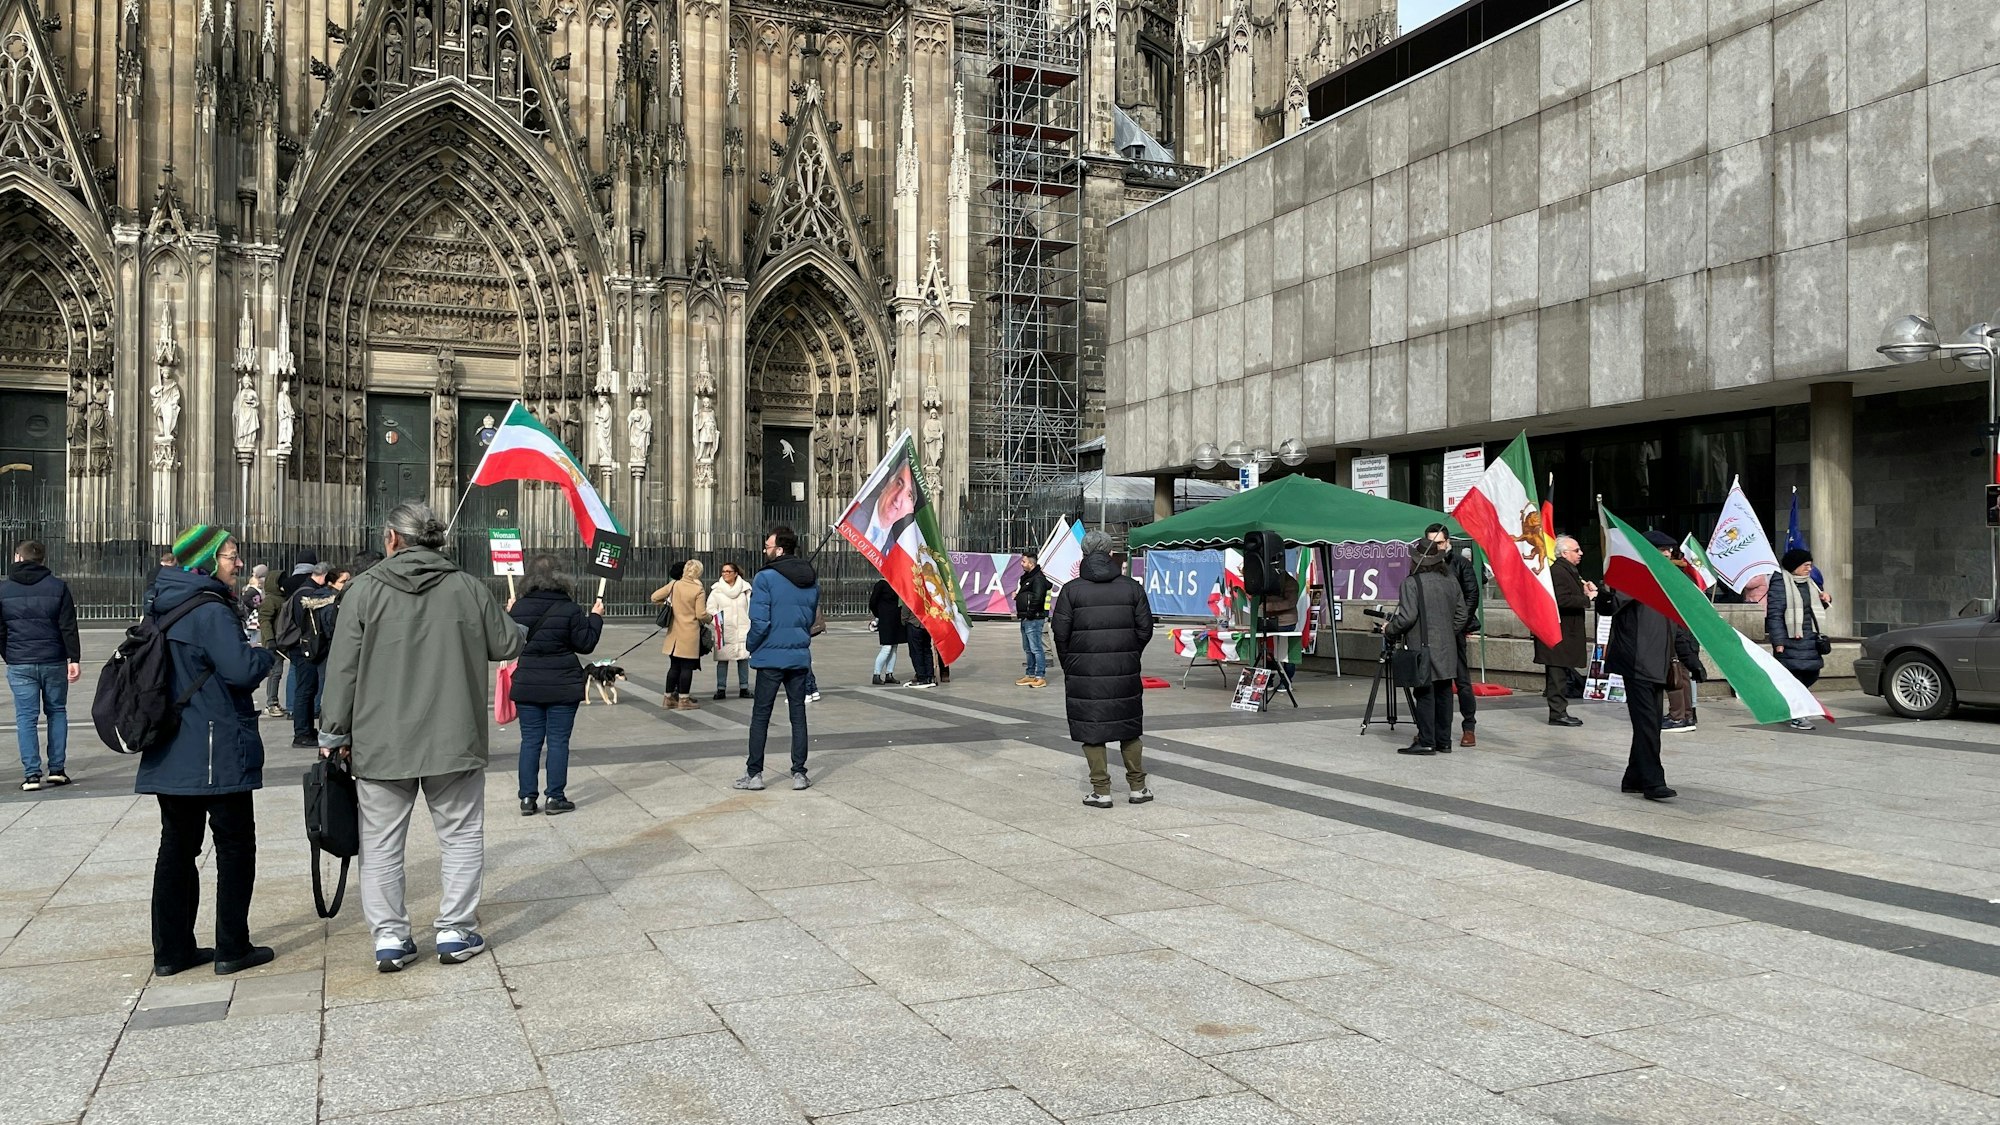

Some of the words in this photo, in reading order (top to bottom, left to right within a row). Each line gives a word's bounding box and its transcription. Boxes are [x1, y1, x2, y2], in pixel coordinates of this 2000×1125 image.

[493, 531, 516, 539] Woman
[500, 541, 511, 549] Life
[840, 523, 857, 543] KING
[857, 540, 868, 554] OF
[867, 550, 883, 567] IRAN
[1333, 541, 1419, 559] Geschicht
[1148, 570, 1198, 596] ALIS
